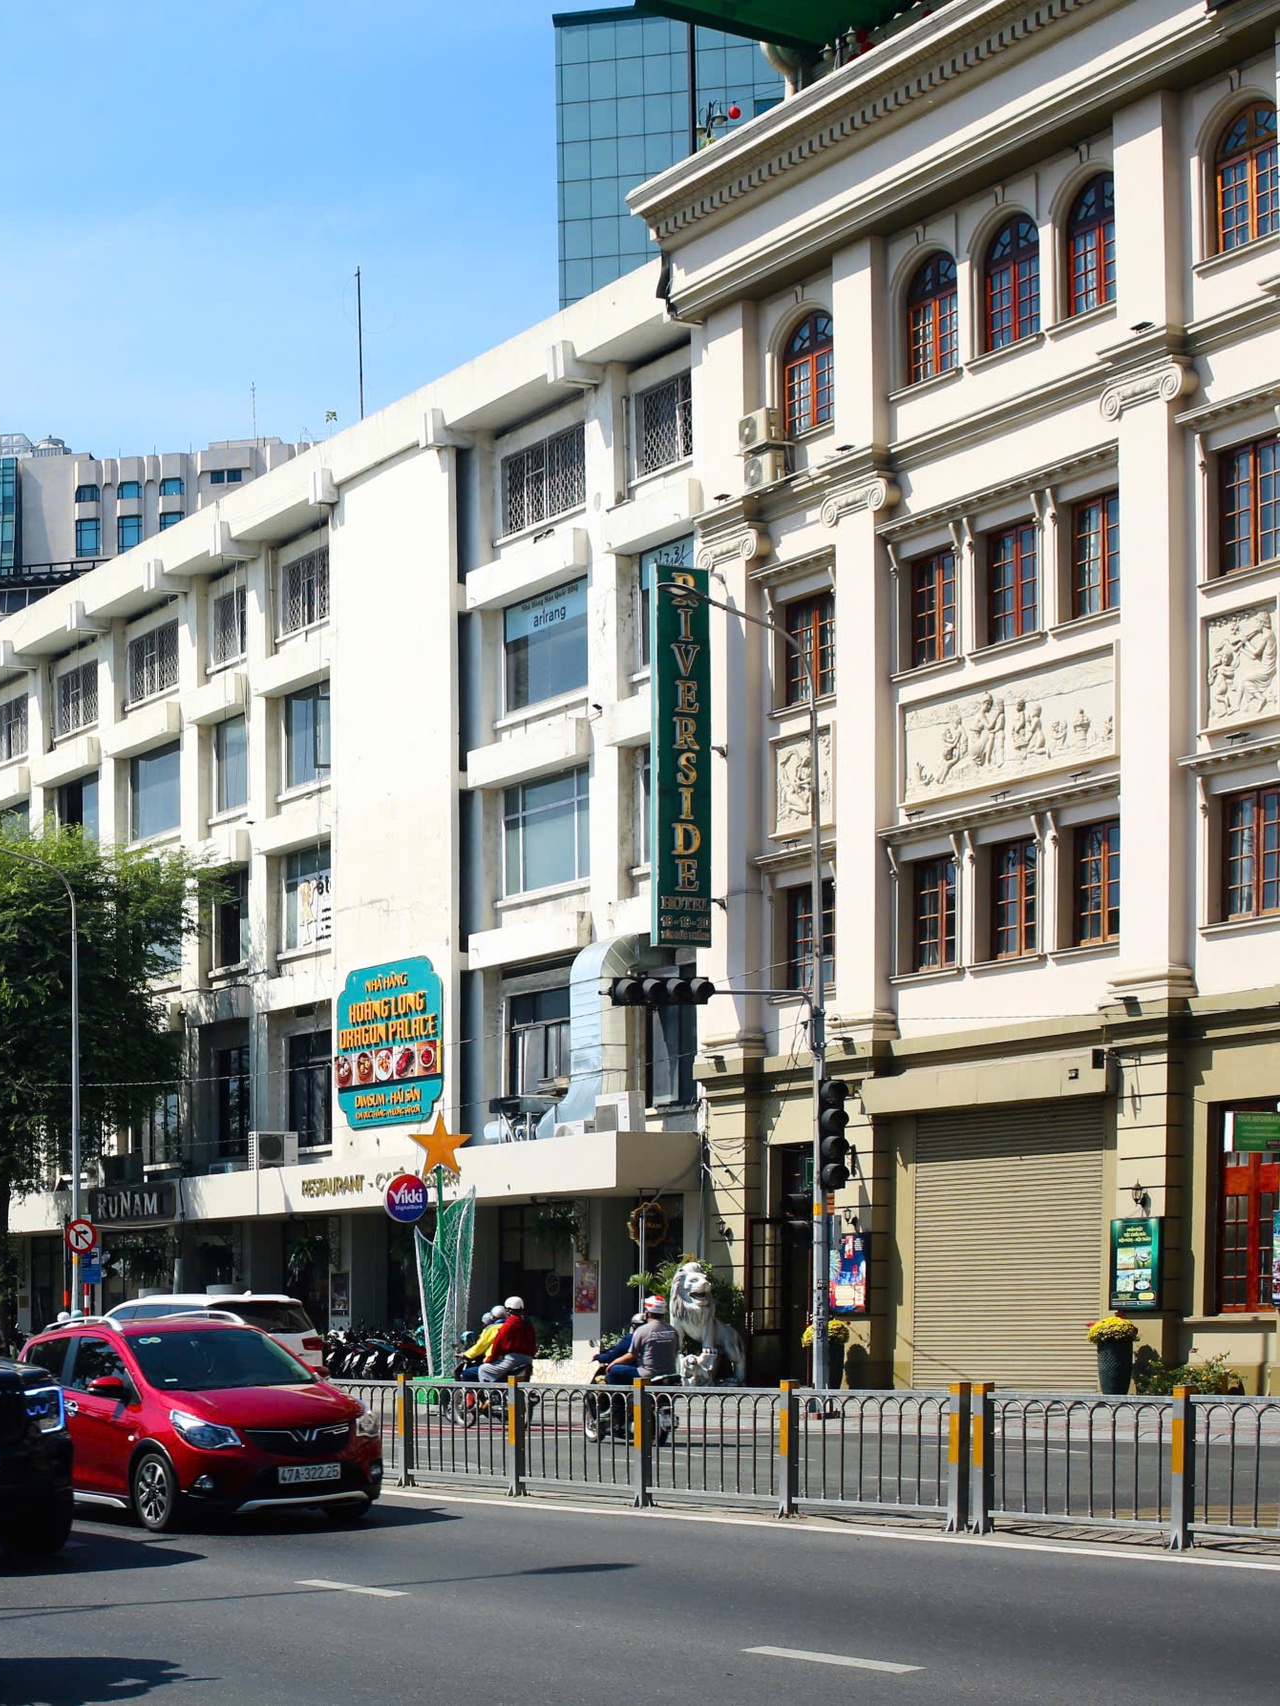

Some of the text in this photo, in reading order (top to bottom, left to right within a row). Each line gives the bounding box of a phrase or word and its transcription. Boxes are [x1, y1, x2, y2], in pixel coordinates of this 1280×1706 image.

[533, 606, 566, 627] arirang
[671, 572, 701, 892] RIVERSIDE
[661, 896, 710, 911] HOTEL
[365, 971, 408, 992] NHÀ HÀNG
[349, 990, 427, 1024] HOÀNG LONG
[339, 1013, 437, 1049] DRAGON PALACE
[355, 1093, 386, 1108] DIMSUM
[302, 1174, 364, 1197] RESTAURANT
[389, 1182, 423, 1205] Vikki
